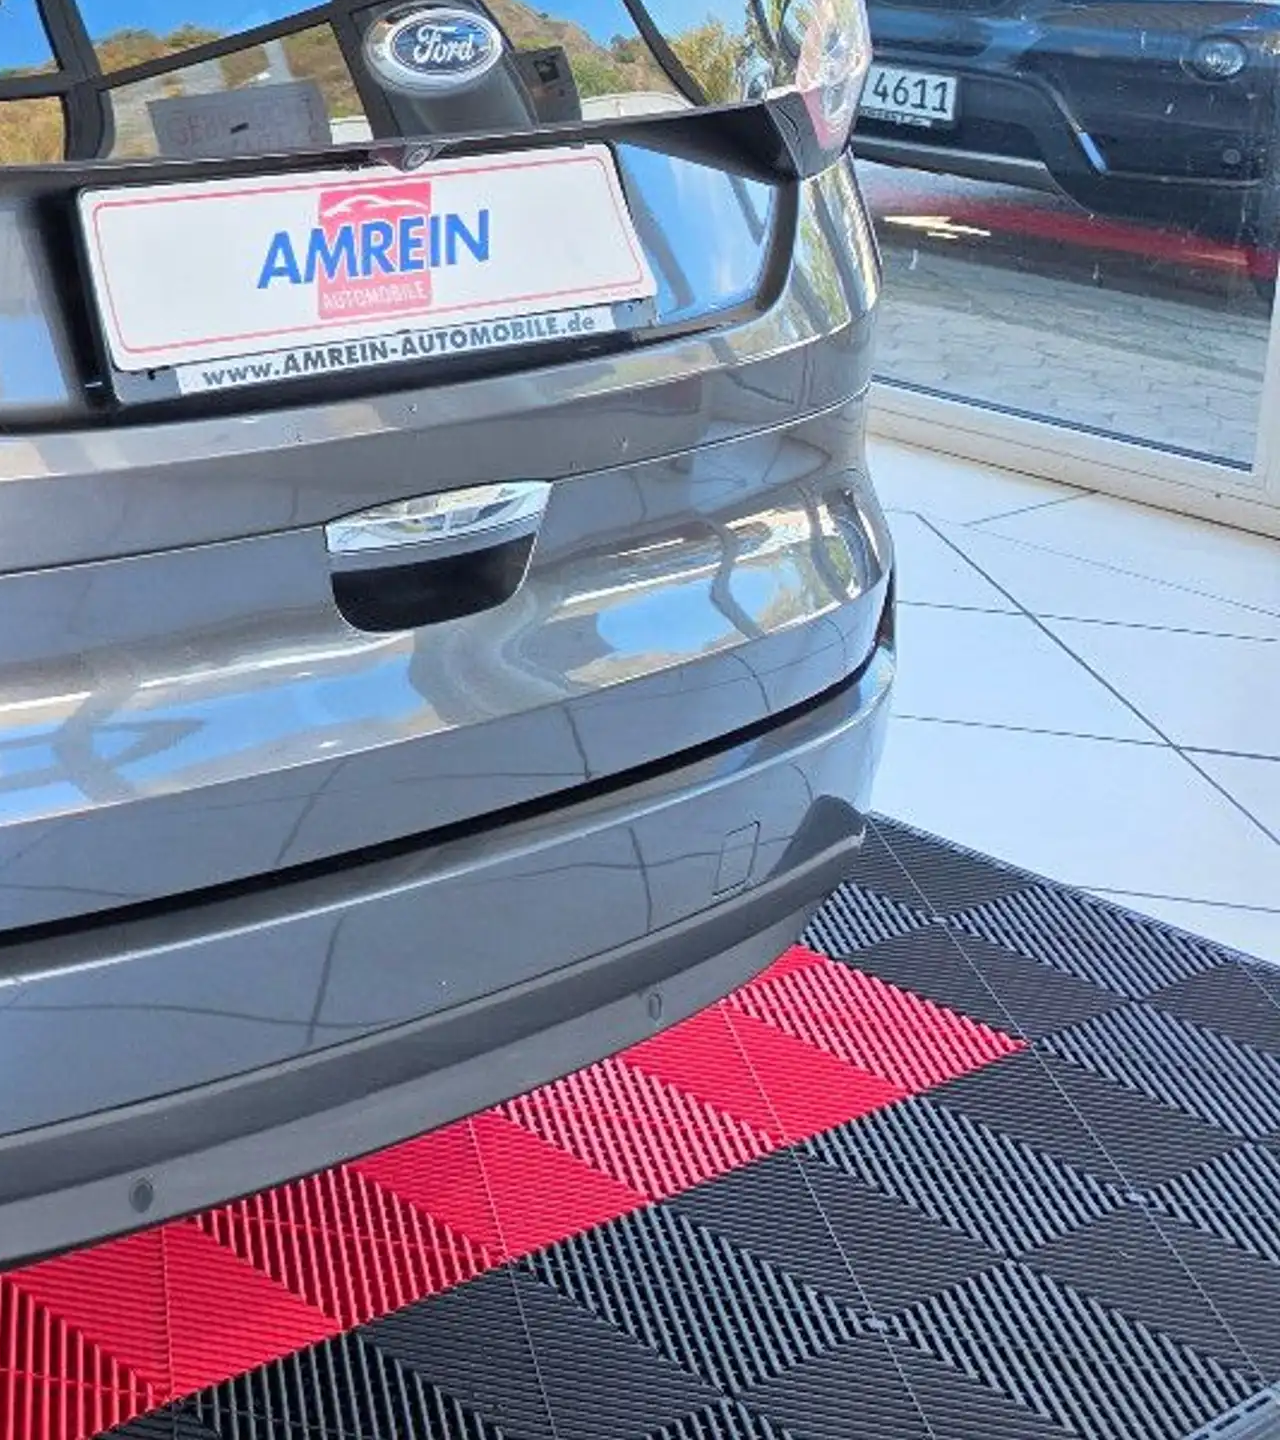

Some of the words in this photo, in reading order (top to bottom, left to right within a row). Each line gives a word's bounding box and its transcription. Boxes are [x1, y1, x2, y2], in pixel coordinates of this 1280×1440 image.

[413, 24, 475, 63] Ford
[872, 72, 947, 114] 4611
[257, 209, 489, 289] AMREIN
[322, 281, 428, 310] AUTOMOBILE
[201, 313, 596, 387] www.AMREIN-AUTOMOBILE.de
